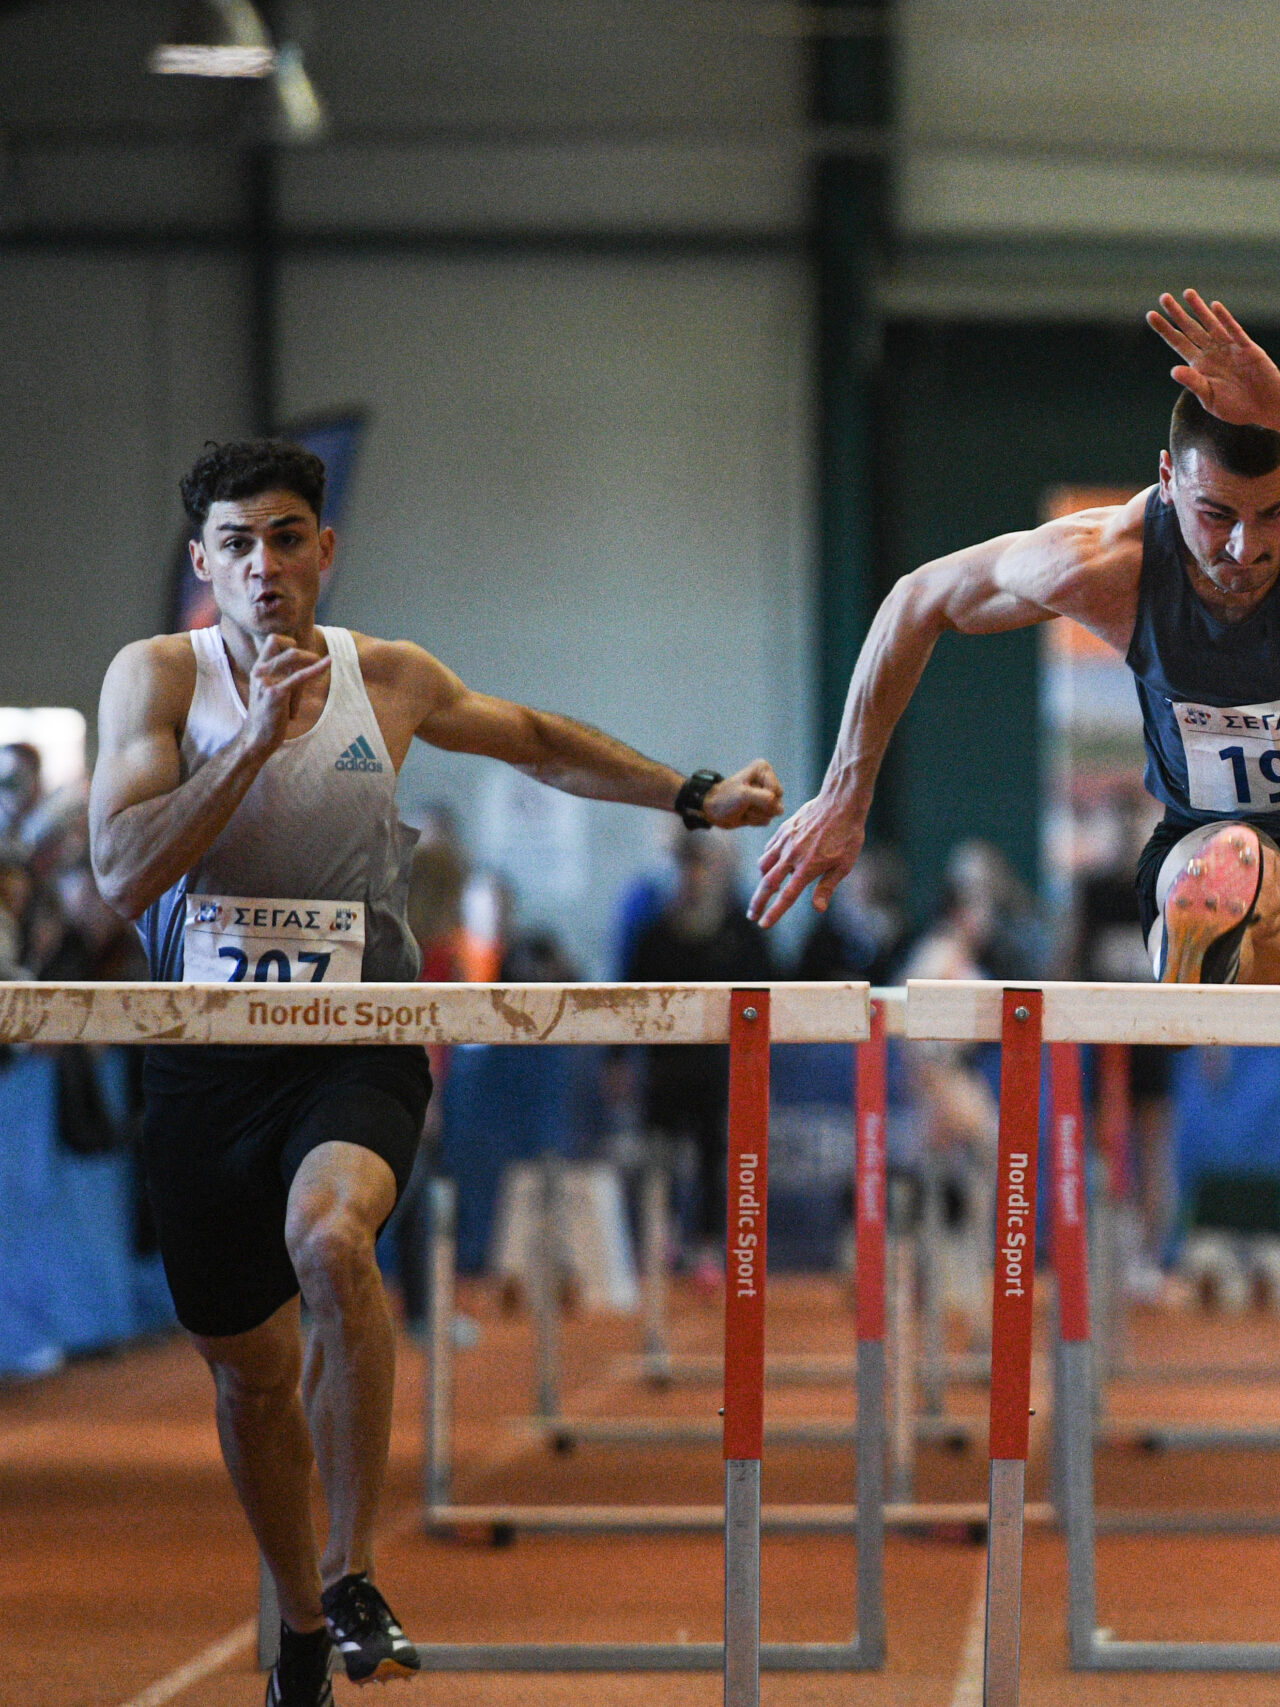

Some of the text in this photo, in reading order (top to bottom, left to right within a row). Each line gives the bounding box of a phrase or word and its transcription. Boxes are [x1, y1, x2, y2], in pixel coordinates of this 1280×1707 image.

[334, 757, 383, 774] adidas
[234, 907, 321, 930] ΣΕΓΑΣ
[354, 1002, 440, 1030] Sport
[732, 1233, 757, 1298] Sport
[1001, 1232, 1026, 1297] Sport
